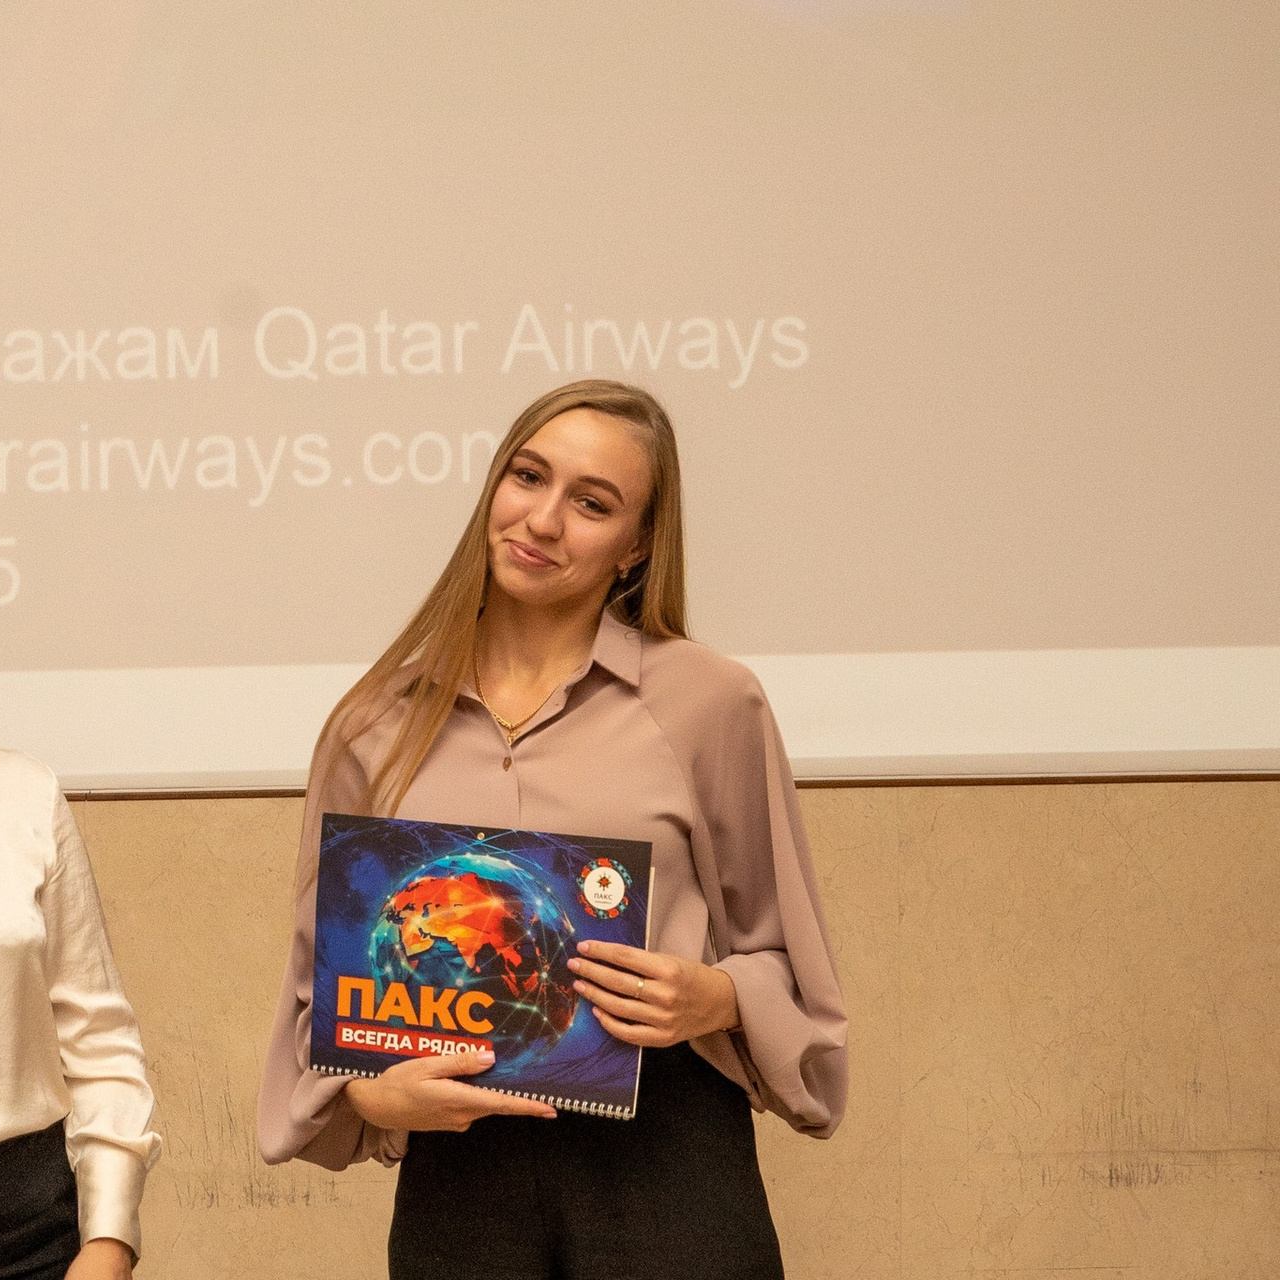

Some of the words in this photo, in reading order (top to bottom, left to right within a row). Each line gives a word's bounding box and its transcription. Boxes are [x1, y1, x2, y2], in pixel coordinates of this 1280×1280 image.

[254, 304, 479, 384] Qatar
[502, 303, 810, 388] Airways
[594, 892, 613, 901] ПАКС
[337, 975, 495, 1034] ПАКС
[341, 1027, 413, 1051] ВСЕГДА
